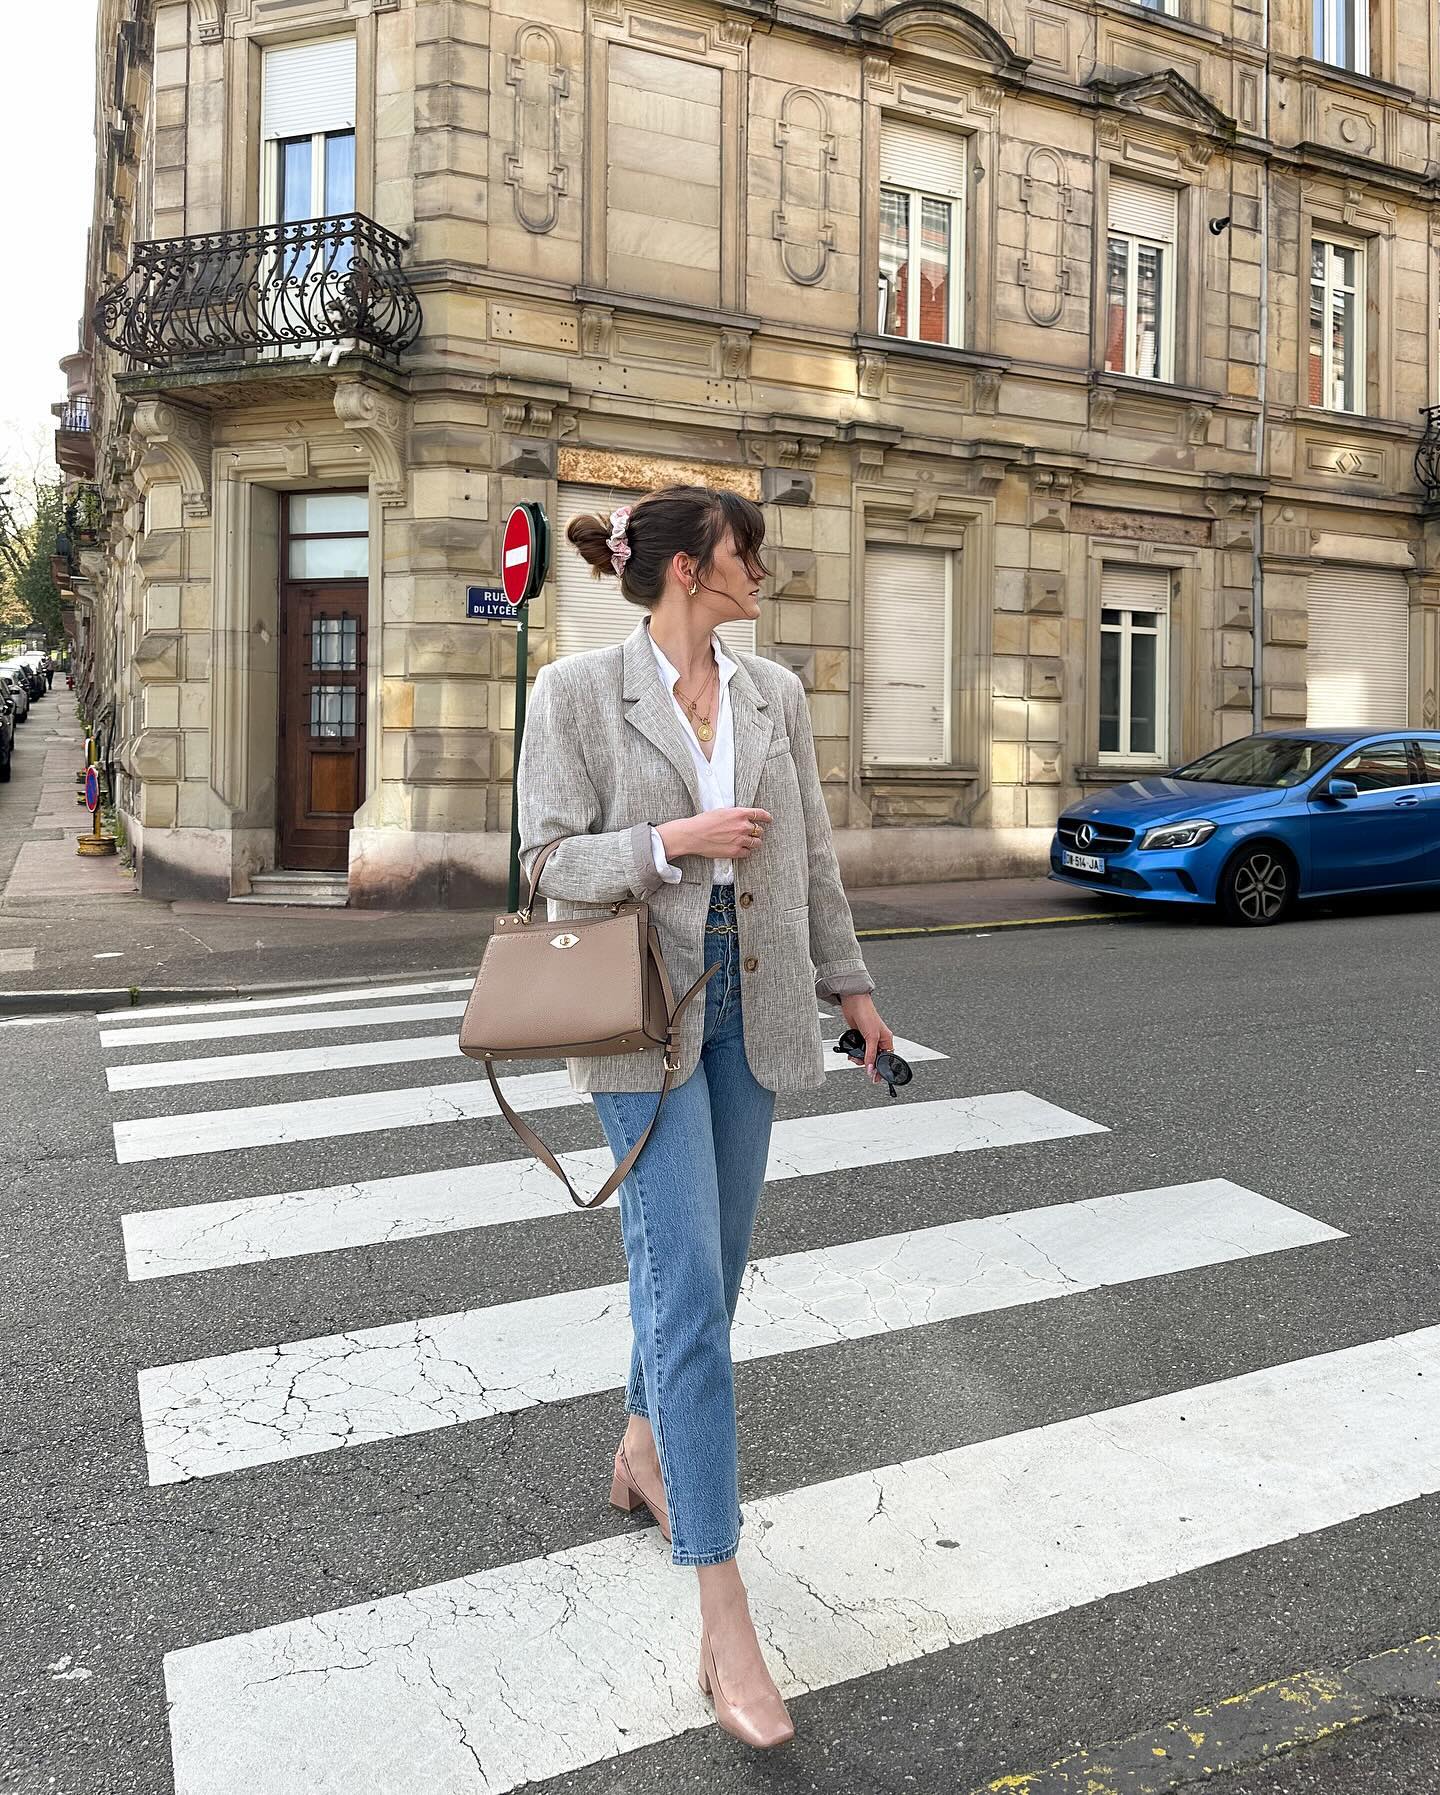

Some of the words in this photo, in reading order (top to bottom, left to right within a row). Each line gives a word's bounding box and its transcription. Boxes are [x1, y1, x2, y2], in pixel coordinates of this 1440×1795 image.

[484, 591, 507, 602] RUE
[473, 605, 485, 613] DU
[487, 604, 518, 616] LYCÉE
